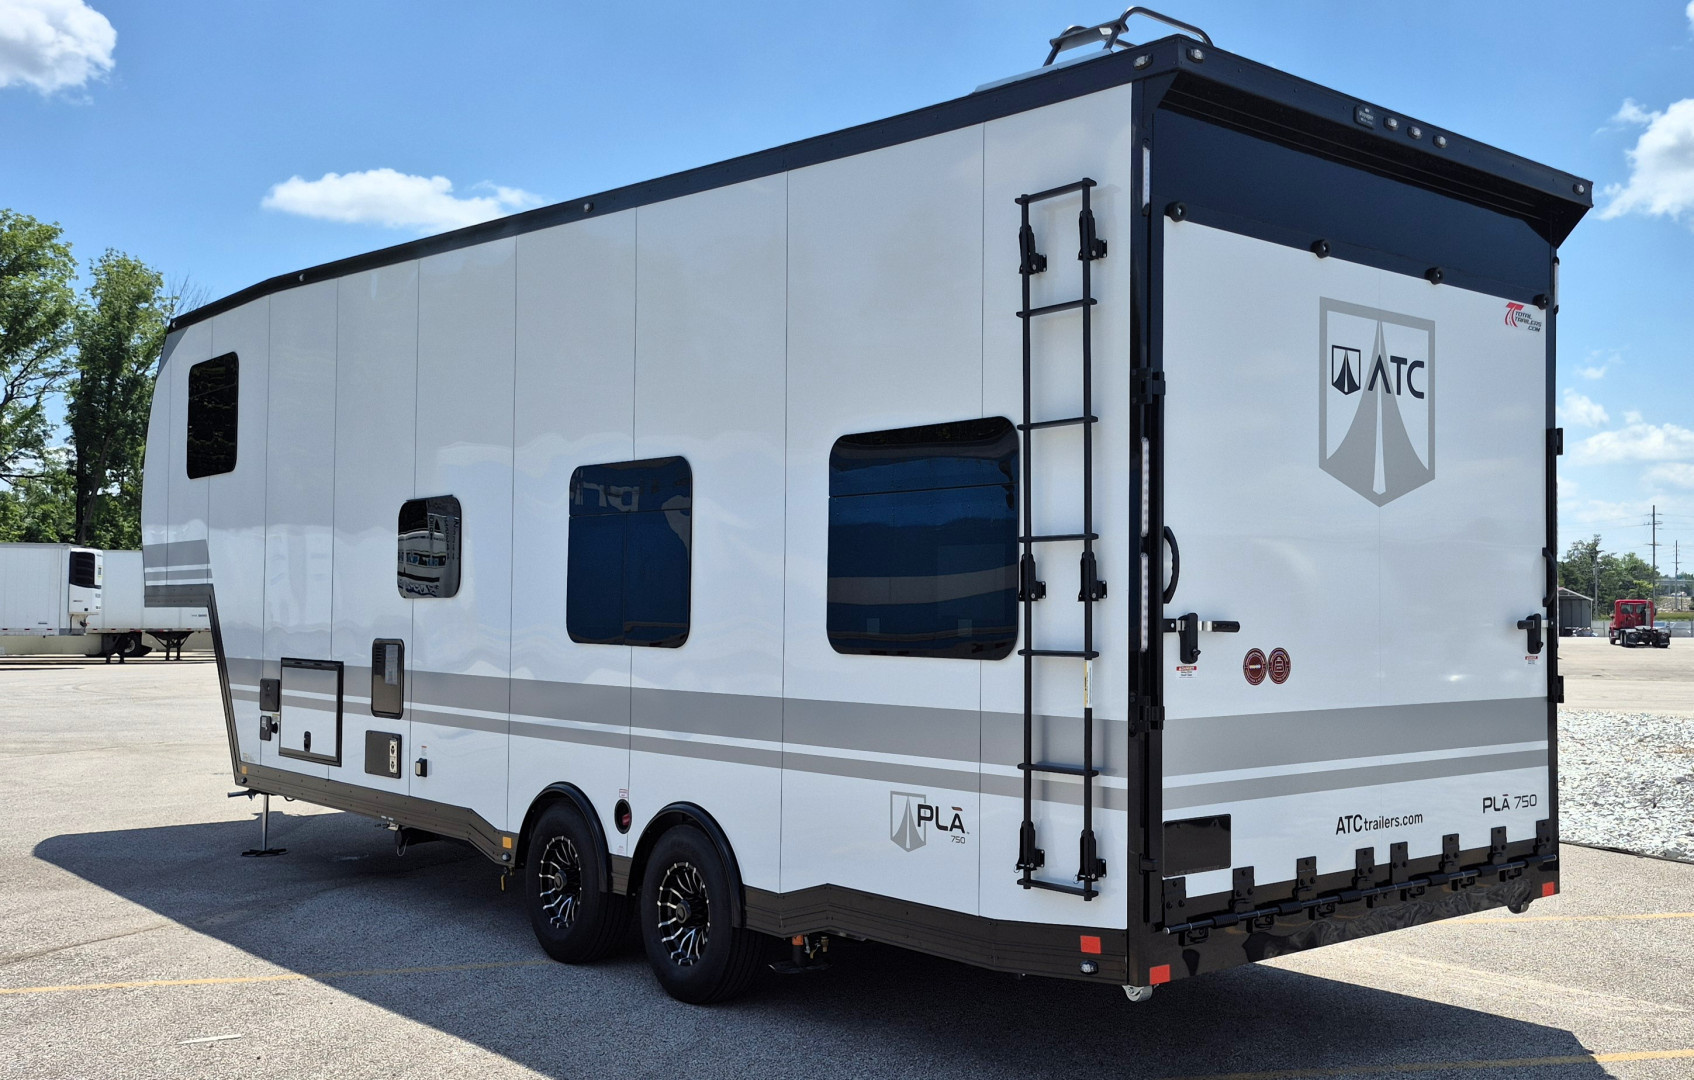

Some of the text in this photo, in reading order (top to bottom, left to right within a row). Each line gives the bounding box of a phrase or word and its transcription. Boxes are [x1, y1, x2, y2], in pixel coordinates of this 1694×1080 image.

[1515, 311, 1532, 320] TOTAL
[1367, 354, 1425, 400] ATC
[1514, 793, 1537, 810] 750
[951, 834, 966, 844] 750
